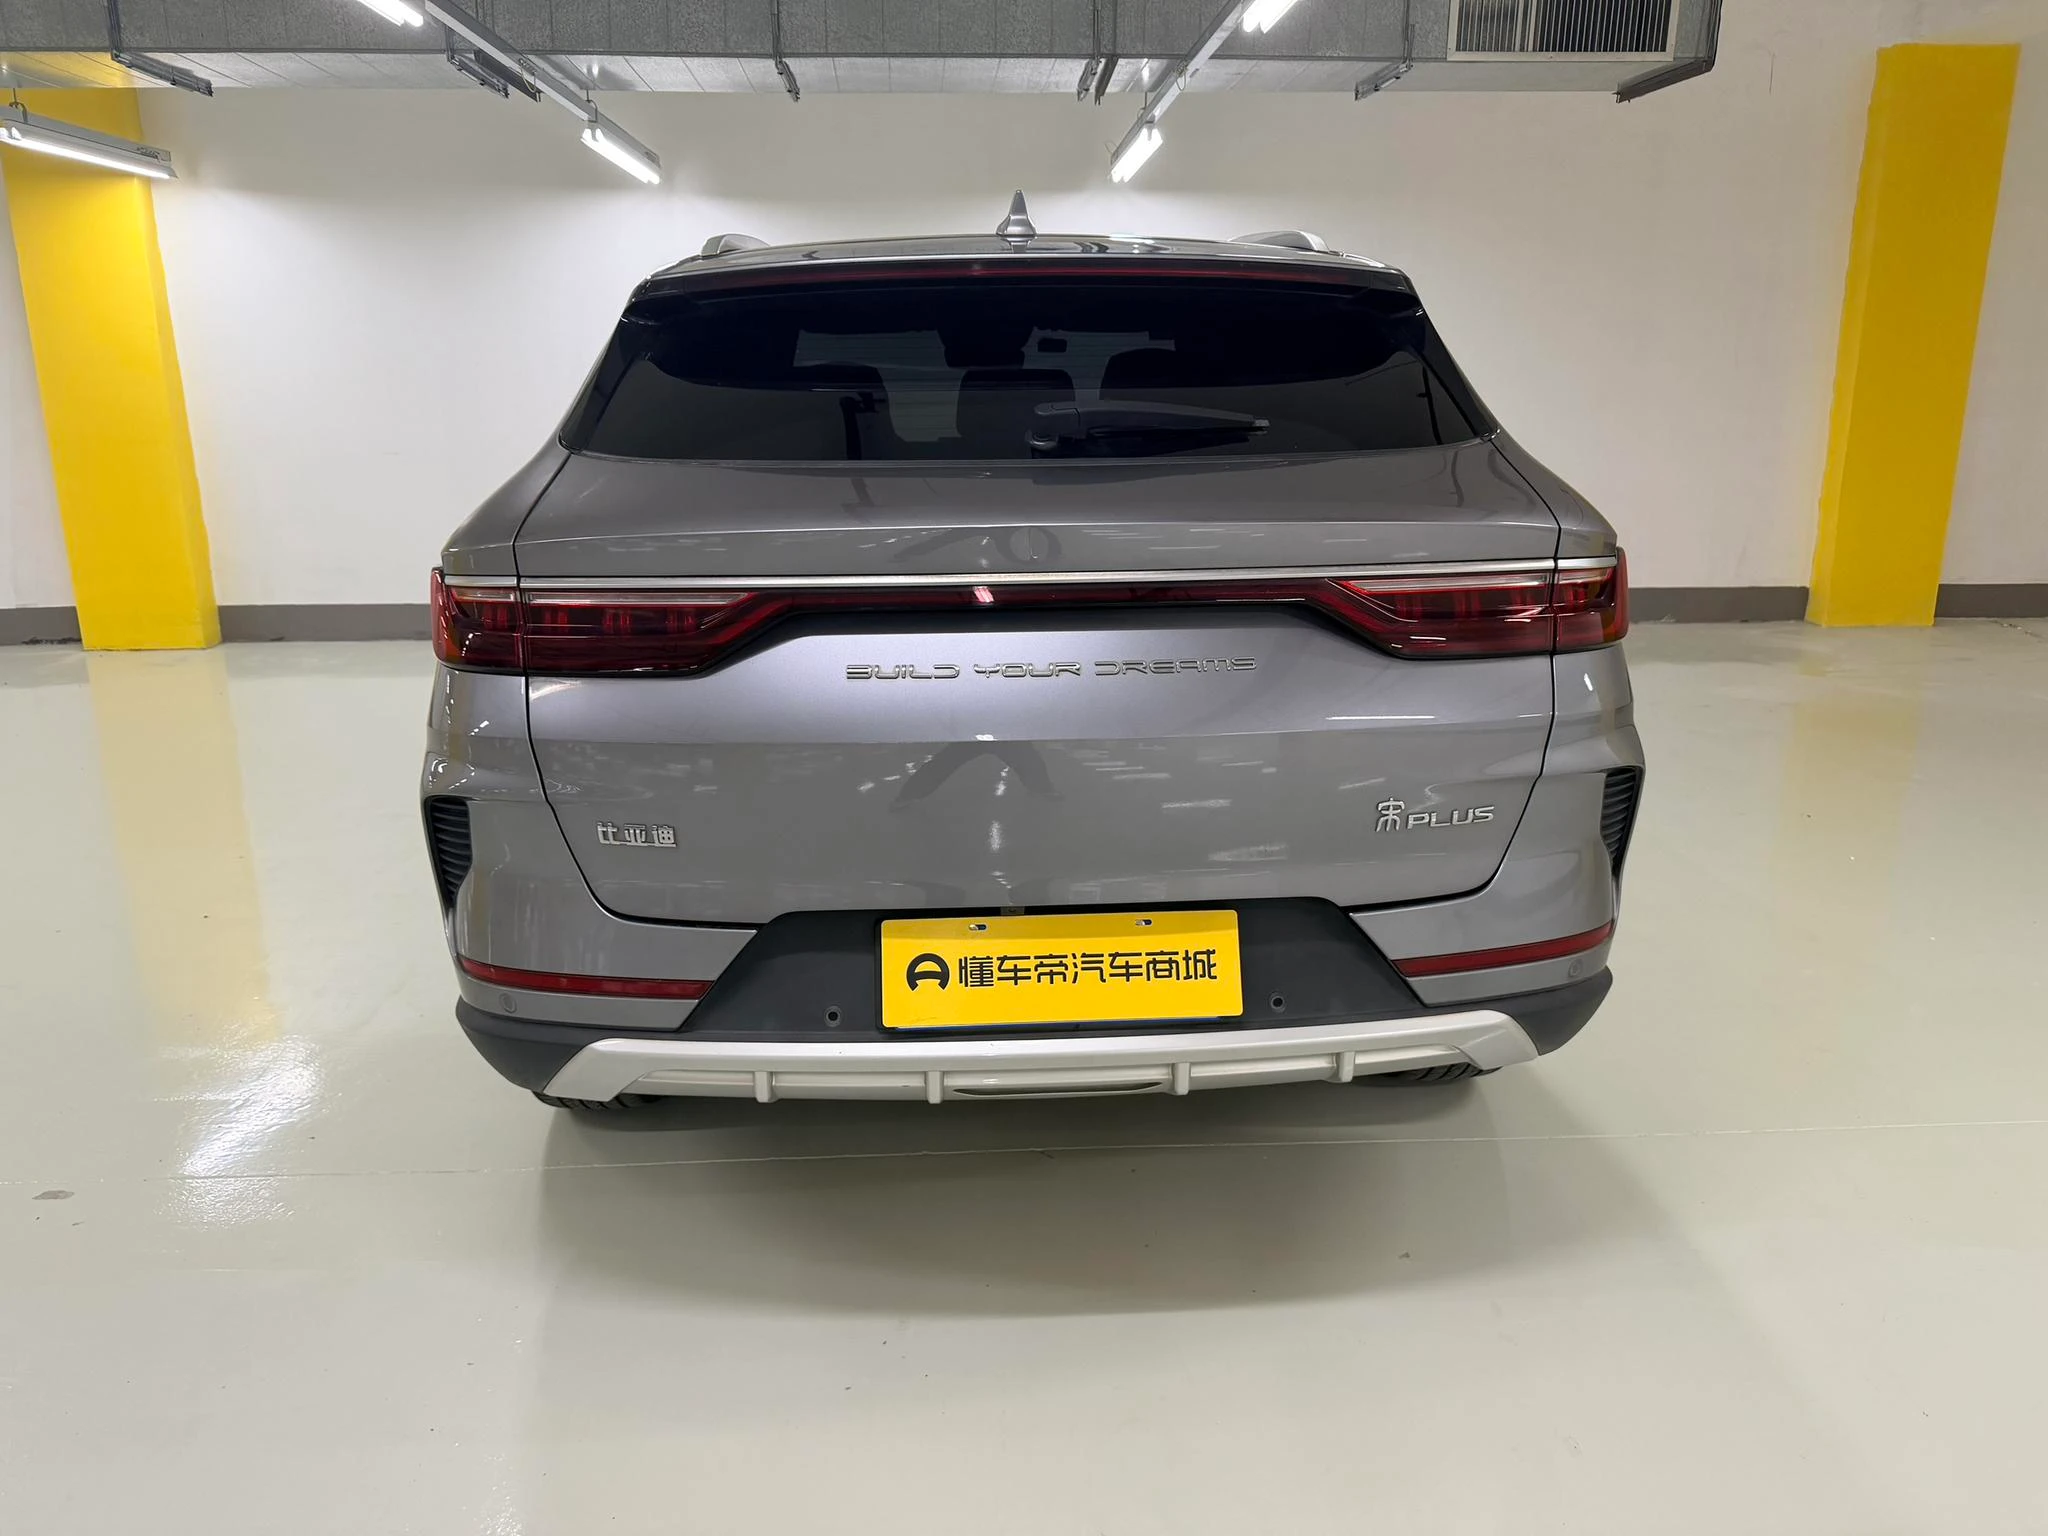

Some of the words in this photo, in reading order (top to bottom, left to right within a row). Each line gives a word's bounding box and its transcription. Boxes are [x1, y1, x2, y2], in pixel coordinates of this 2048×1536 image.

[846, 664, 960, 680] BUILD
[973, 661, 1081, 679] YOUR
[1094, 656, 1258, 676] DREAMS
[1407, 806, 1495, 830] PLUS
[597, 822, 677, 848] 比亚迪
[958, 948, 1218, 988] 懂车帝汽车商城
